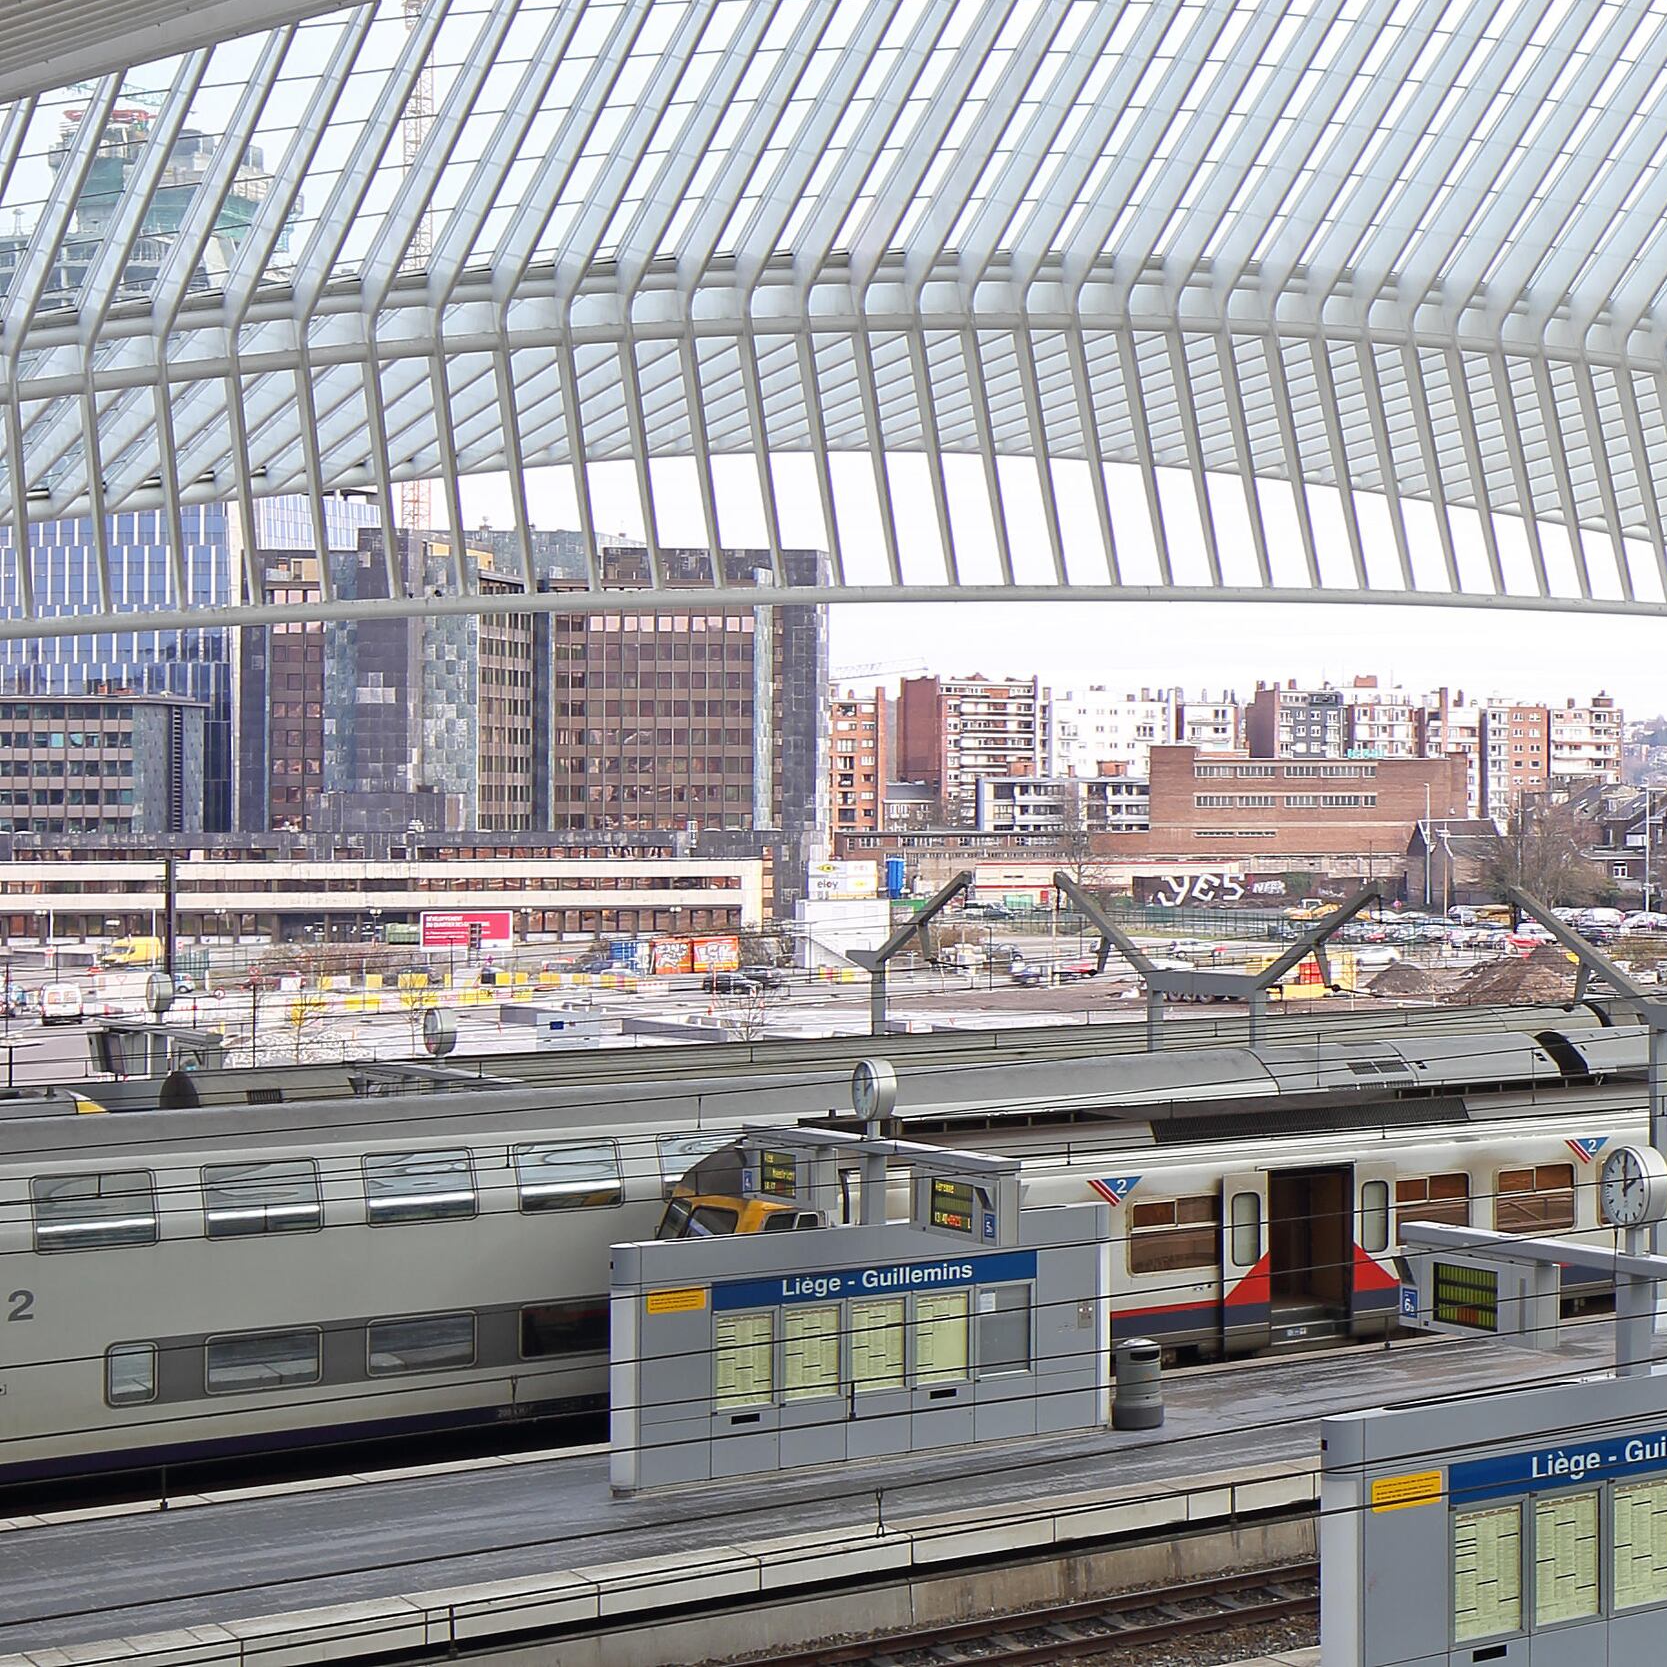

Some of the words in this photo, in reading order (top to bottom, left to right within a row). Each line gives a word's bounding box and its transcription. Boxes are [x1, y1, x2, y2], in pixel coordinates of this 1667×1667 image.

[817, 879, 838, 889] eloy
[1588, 1139, 1597, 1153] 2
[1116, 1179, 1128, 1194] 2
[781, 1276, 841, 1297] Liège
[862, 1264, 973, 1288] Guillemins
[8, 1289, 34, 1321] 2
[1404, 1297, 1415, 1313] 6b
[1531, 1449, 1600, 1480] Liège
